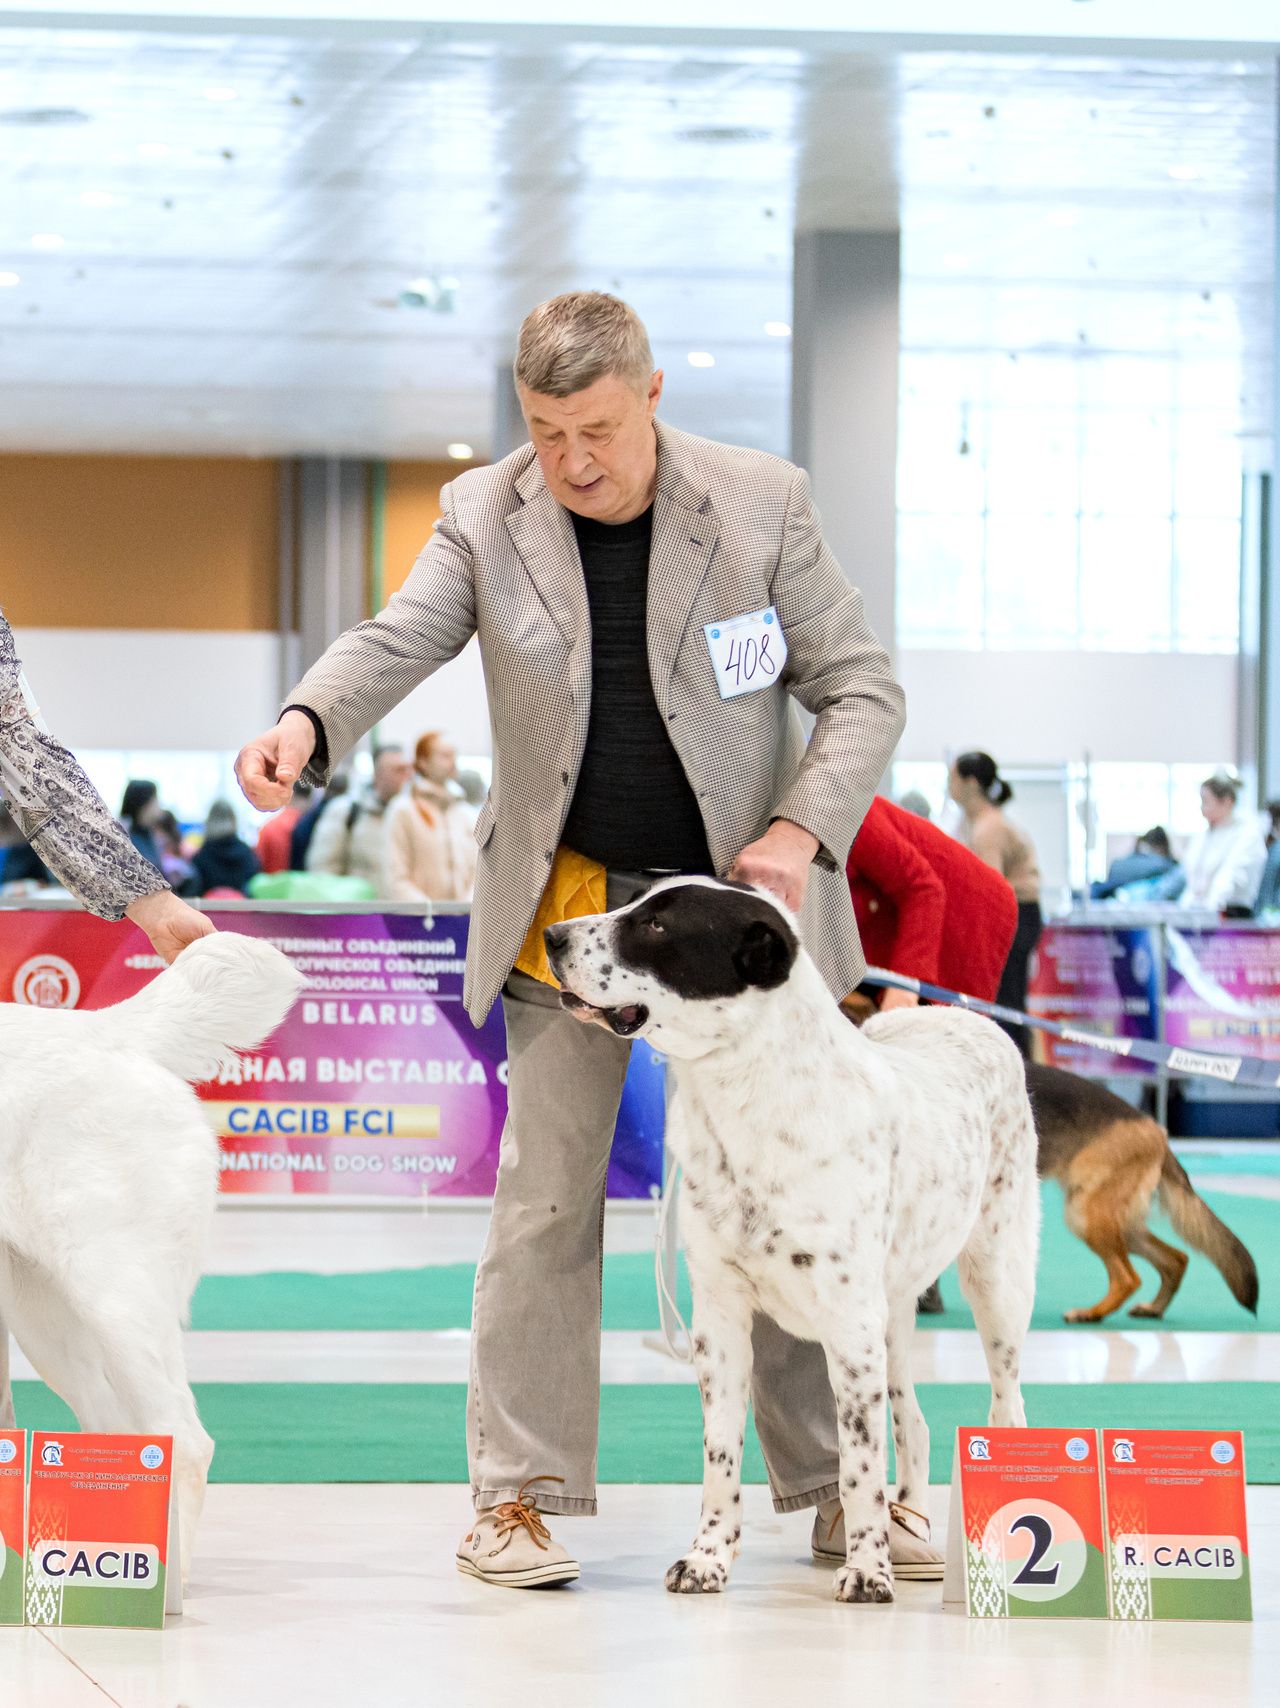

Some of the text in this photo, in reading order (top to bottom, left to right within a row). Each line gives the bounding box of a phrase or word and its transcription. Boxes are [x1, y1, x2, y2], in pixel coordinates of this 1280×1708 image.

[725, 633, 775, 686] 408
[346, 937, 456, 955] ОБЪЕДИНЕНИЙ
[287, 957, 381, 972] ОГИЧЕСКОЕ
[391, 977, 438, 992] UNION
[303, 1001, 437, 1026] BELARUS
[317, 1057, 487, 1085] ВЫСТАВКА
[228, 1107, 394, 1135] CACIB FCI
[334, 1154, 383, 1173] DOG
[392, 1155, 458, 1174] SHOW
[95, 1472, 168, 1483] КИНОЛОГИЧЕСКОЕ
[1008, 1514, 1061, 1586] 2
[1124, 1546, 1236, 1569] R. CACIB
[41, 1548, 151, 1580] CACIB
